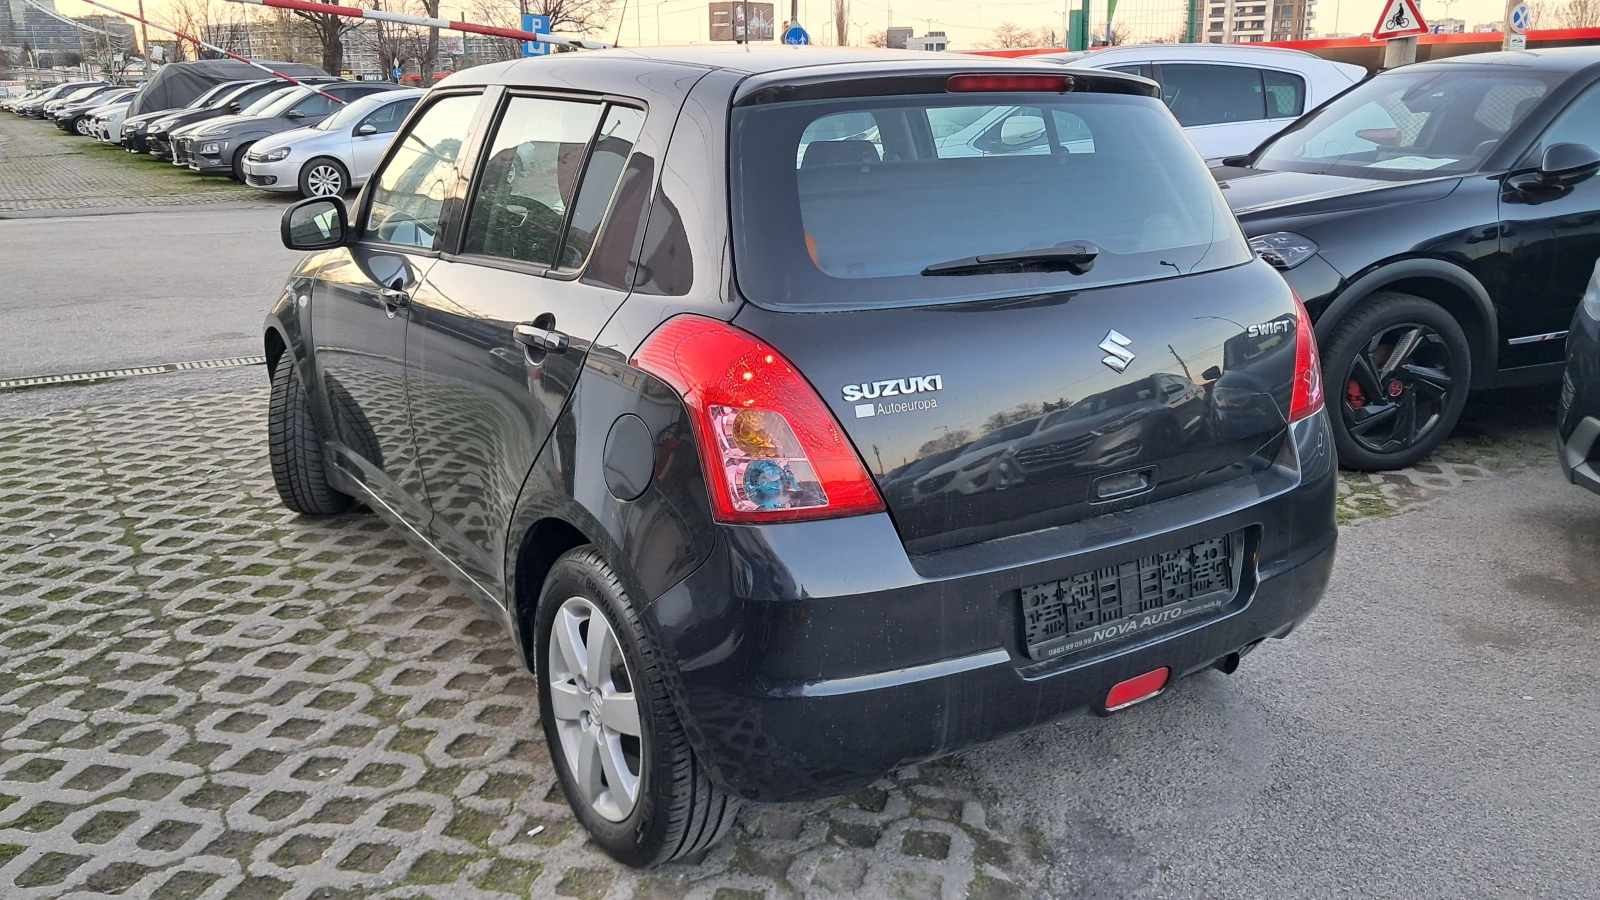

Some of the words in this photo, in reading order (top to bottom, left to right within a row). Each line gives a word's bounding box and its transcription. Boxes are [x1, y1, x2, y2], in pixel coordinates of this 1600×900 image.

[532, 18, 542, 34] P
[1247, 319, 1290, 338] SWIFT
[842, 374, 943, 402] SUZUKI
[877, 398, 938, 416] Autoeuropa
[1048, 645, 1065, 656] 0885
[1074, 640, 1083, 648] 09
[1083, 637, 1092, 645] 99
[1093, 621, 1137, 642] NOVA
[1139, 607, 1182, 628] AUTO
